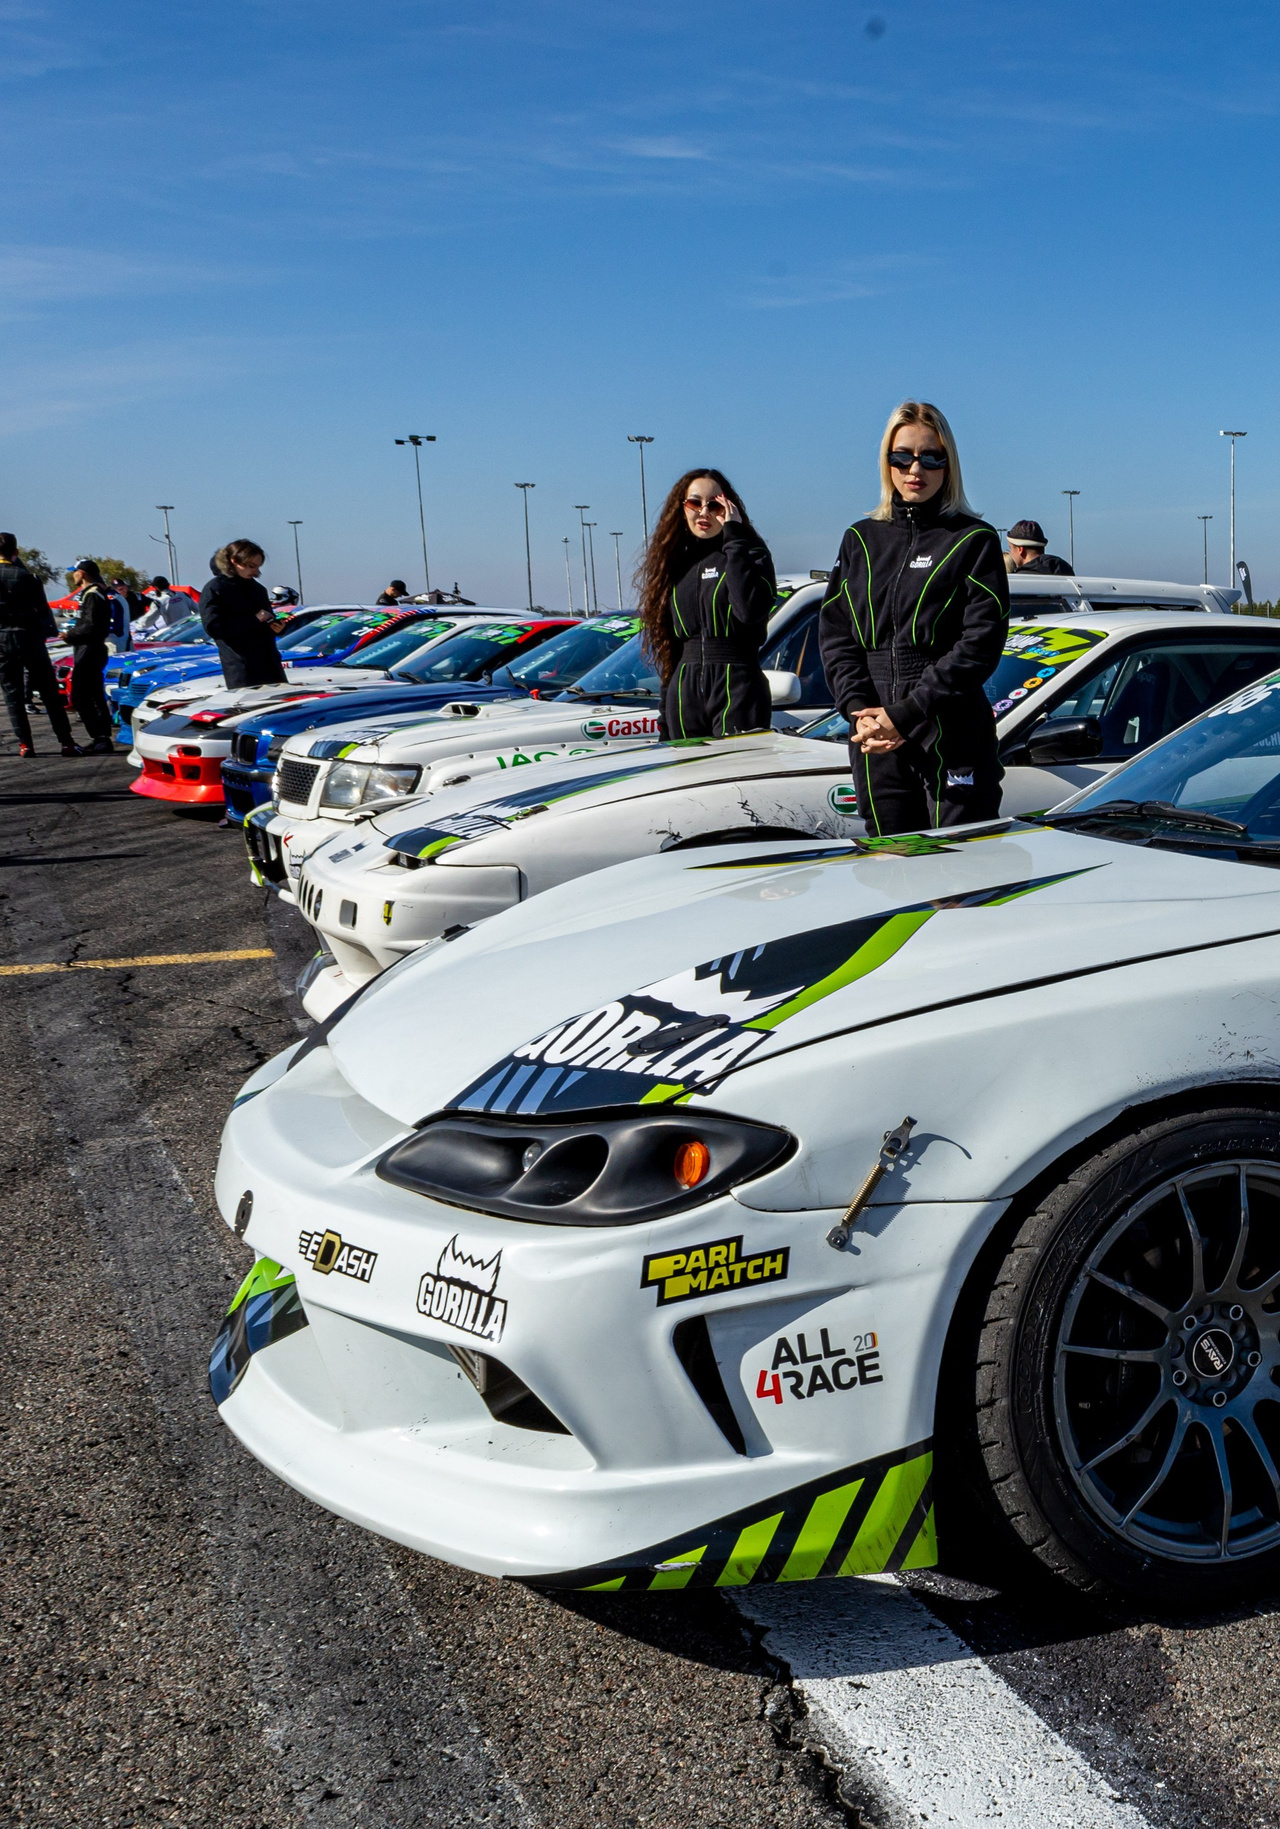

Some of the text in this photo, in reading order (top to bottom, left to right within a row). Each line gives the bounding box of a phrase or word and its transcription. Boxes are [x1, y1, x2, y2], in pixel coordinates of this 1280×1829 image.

[608, 717, 661, 738] Castr
[648, 1242, 736, 1281] PARI
[664, 1254, 783, 1299] MATCH
[417, 1275, 506, 1343] GORILLA
[771, 1327, 846, 1370] ALL
[1200, 1339, 1224, 1371] RAYS
